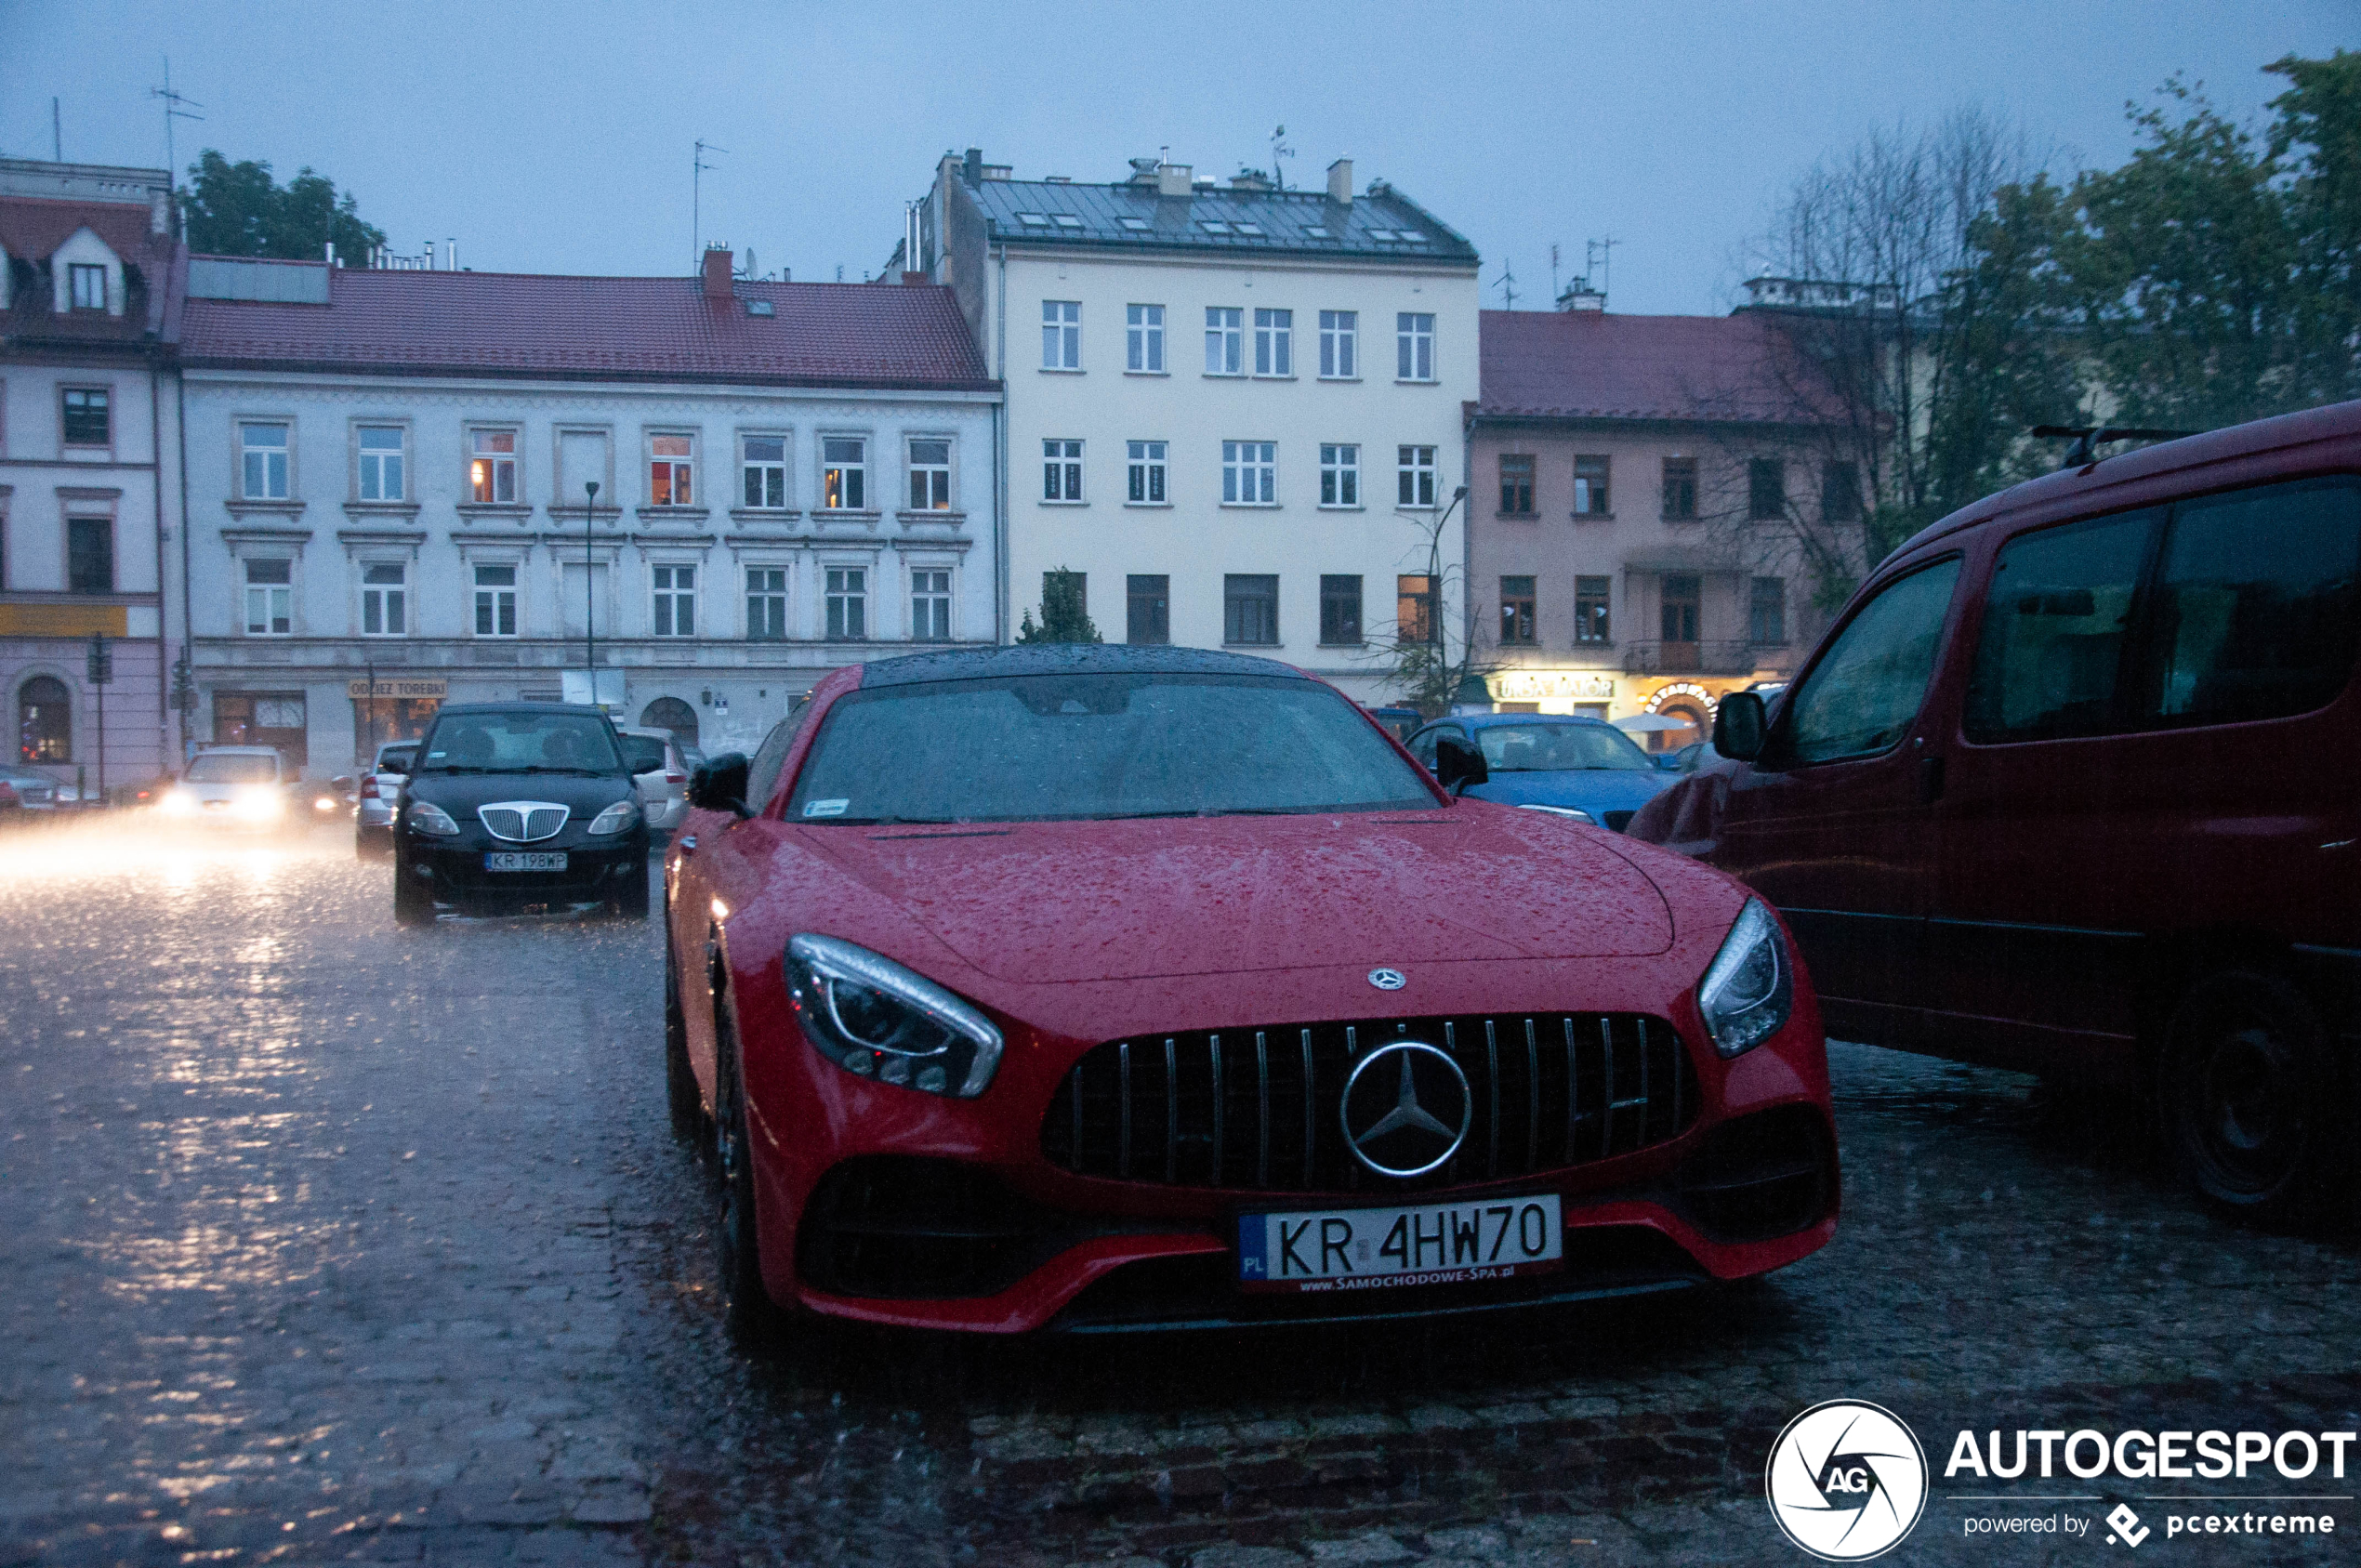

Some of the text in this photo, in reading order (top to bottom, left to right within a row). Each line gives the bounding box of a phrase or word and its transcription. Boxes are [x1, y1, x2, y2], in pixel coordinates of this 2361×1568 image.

[397, 683, 445, 694] TOREBKI
[1500, 679, 1546, 697] URSA
[494, 854, 565, 868] KR 198WP
[1279, 1203, 1547, 1276] KR 4HW70
[1243, 1257, 1264, 1273] PL
